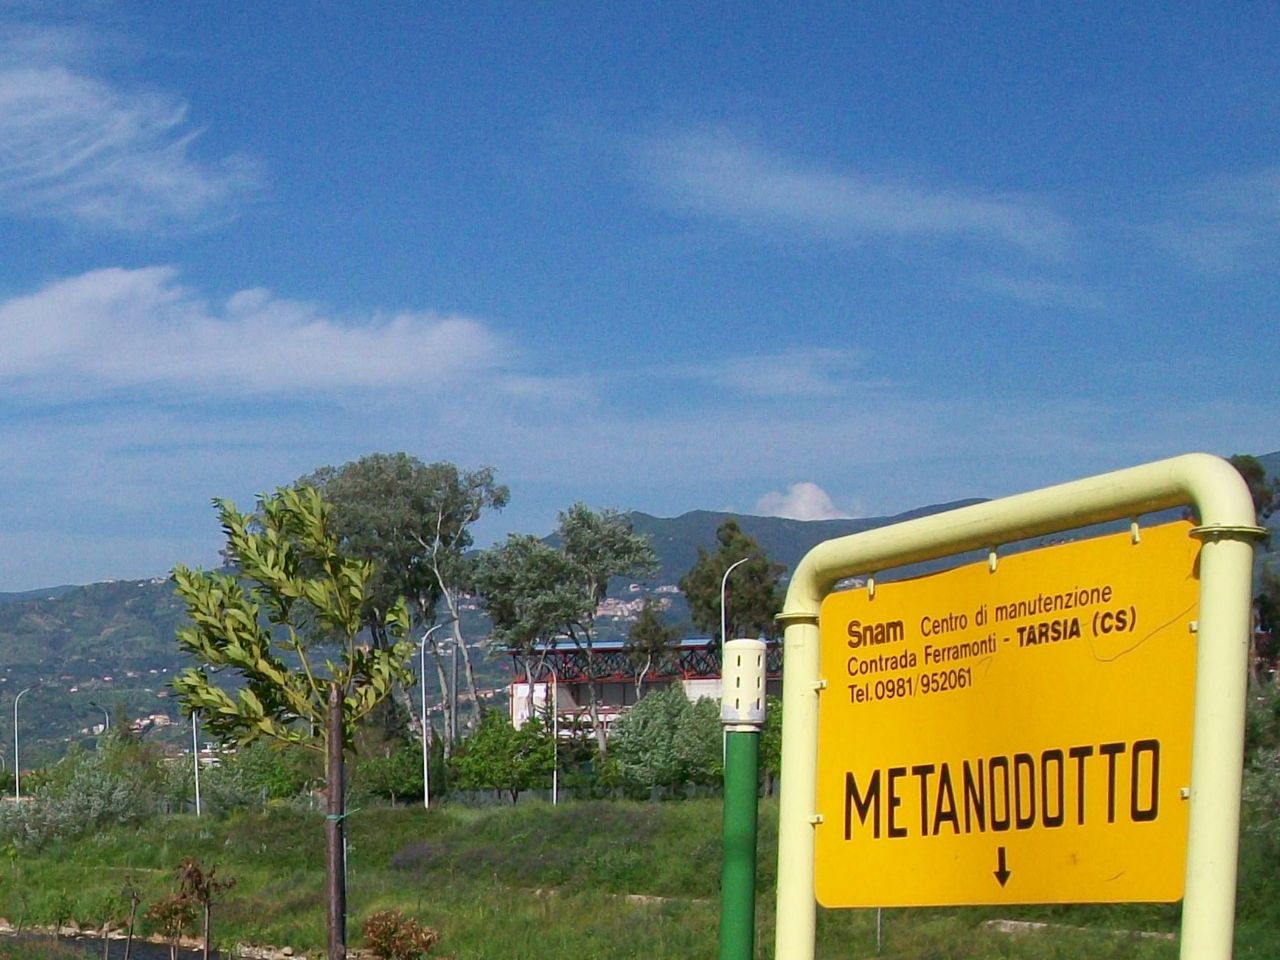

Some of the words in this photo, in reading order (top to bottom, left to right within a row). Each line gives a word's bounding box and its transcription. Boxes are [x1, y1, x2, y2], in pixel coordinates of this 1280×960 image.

[847, 620, 904, 648] Snam
[920, 612, 968, 637] Centro
[975, 604, 988, 626] di
[995, 585, 1112, 622] manutenzione
[847, 649, 917, 676] Contrada
[924, 633, 997, 665] Ferramonti
[1017, 617, 1081, 647] TARSIA
[1092, 605, 1136, 637] (CS)
[844, 739, 1160, 841] METANODOTTO
